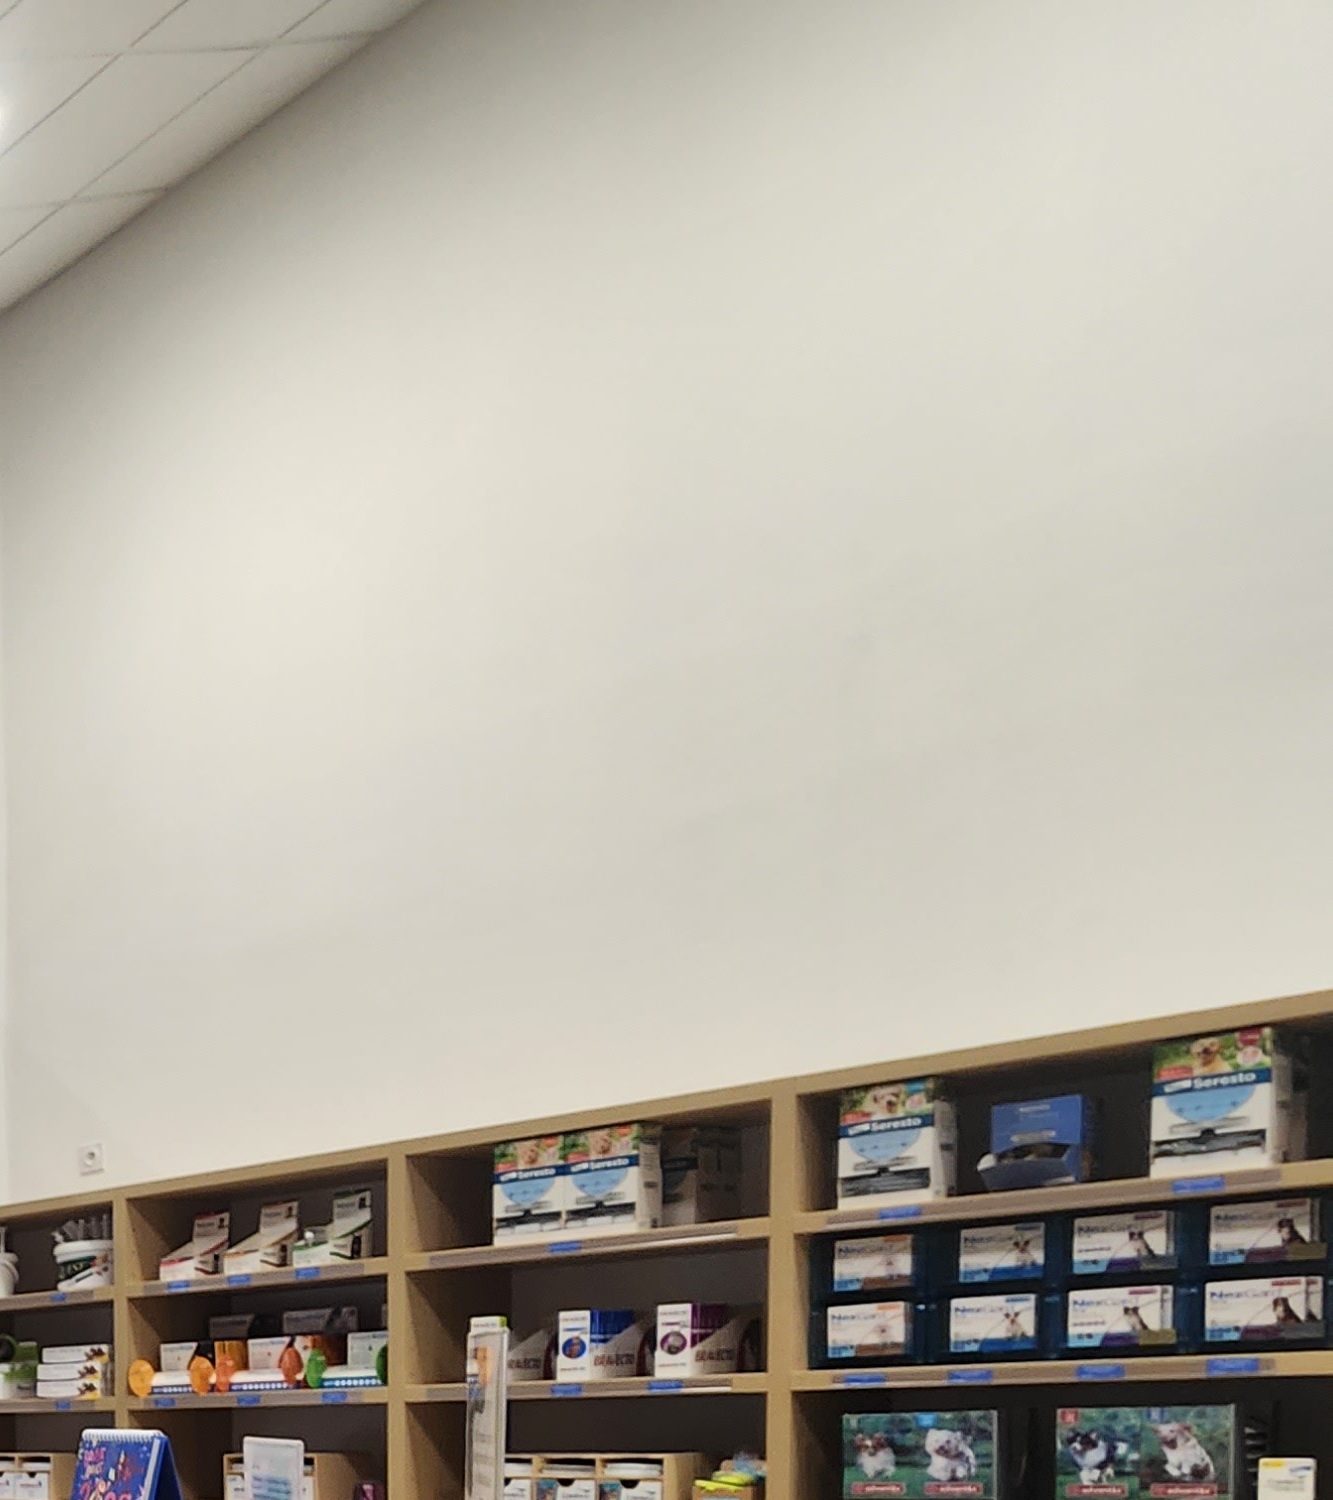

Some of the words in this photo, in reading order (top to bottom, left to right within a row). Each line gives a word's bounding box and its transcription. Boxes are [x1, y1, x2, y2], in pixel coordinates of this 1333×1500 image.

[1193, 1071, 1257, 1089] Seresto
[871, 1116, 922, 1132] Seresto
[589, 1157, 630, 1171] Seresto
[517, 1166, 557, 1179] Seresto
